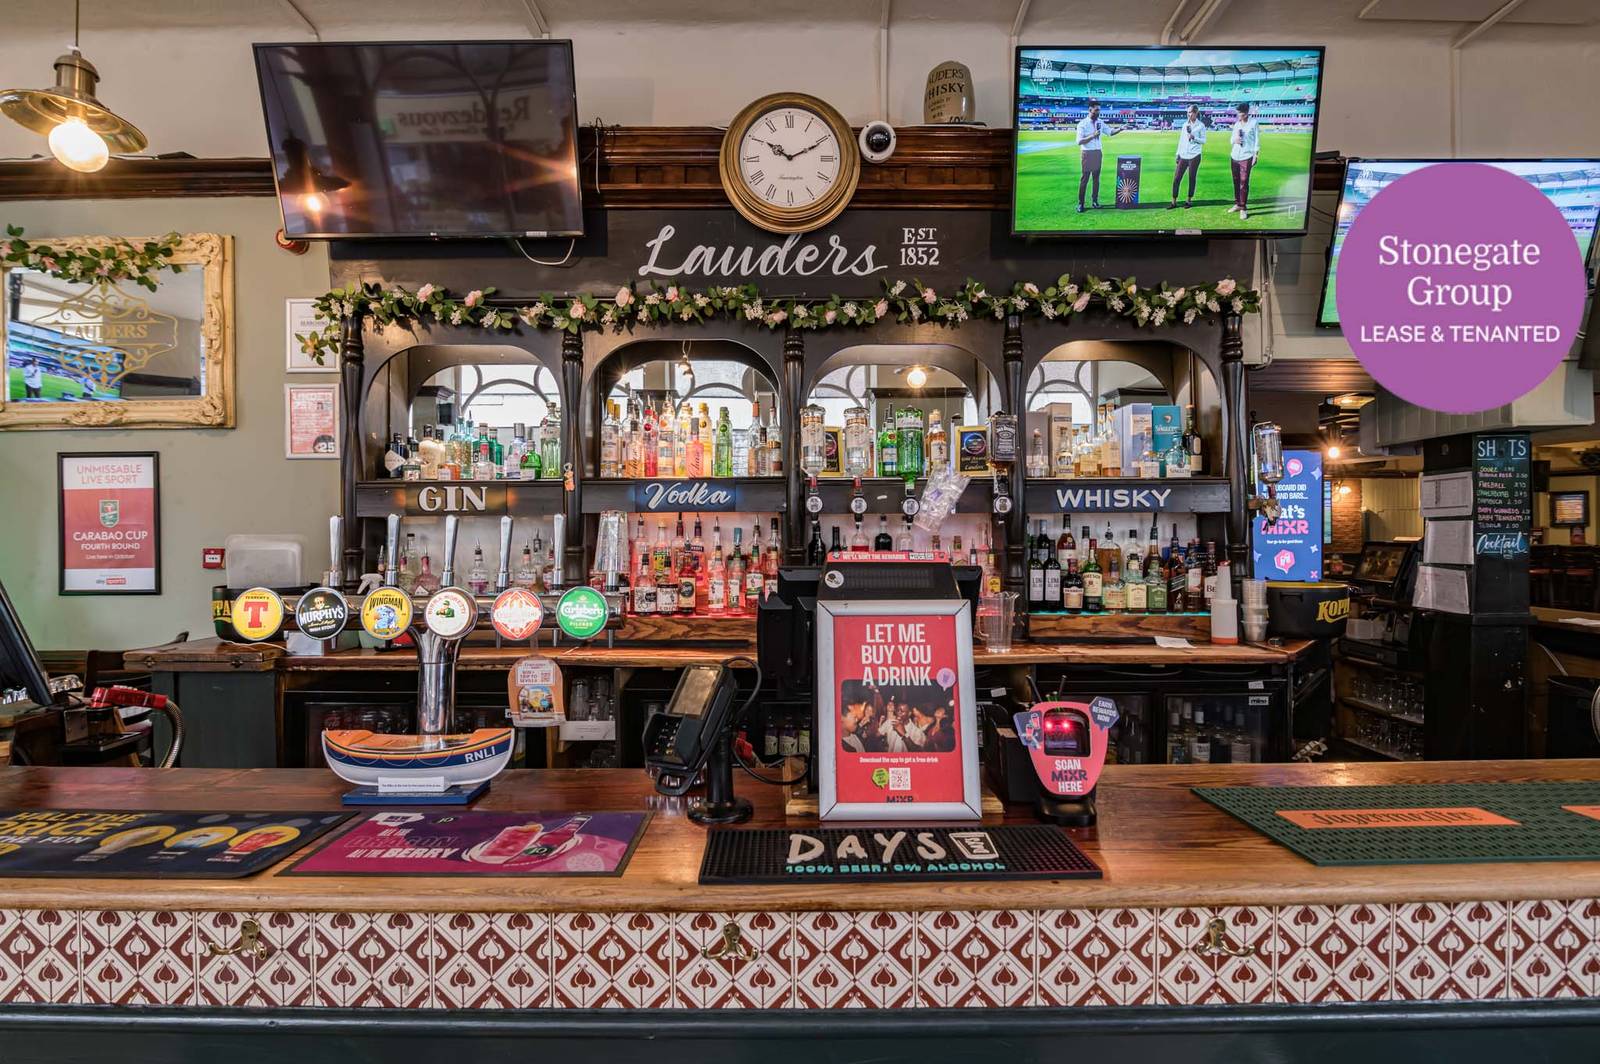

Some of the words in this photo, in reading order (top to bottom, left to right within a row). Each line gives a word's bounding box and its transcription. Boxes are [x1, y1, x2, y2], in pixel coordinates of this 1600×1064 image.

[928, 82, 965, 99] HISKY
[638, 225, 888, 276] Lauders
[900, 247, 939, 266] 1852
[61, 325, 148, 339] LAUDERS
[1478, 440, 1526, 457] SHTS
[77, 464, 143, 474] UNMISSABLE
[81, 475, 102, 484] LIVE
[105, 474, 138, 484] SPORT
[418, 486, 488, 512] GIN
[645, 482, 732, 509] Vodka
[1056, 488, 1172, 508] WHISKY
[73, 532, 123, 541] CARABAO
[126, 530, 148, 540] CUP
[368, 598, 404, 611] WINGMAN
[560, 602, 604, 620] Carlsberg
[244, 601, 268, 628] T
[299, 606, 344, 626] MURPHY'S
[866, 624, 894, 643] LET
[899, 624, 926, 643] ME
[862, 645, 896, 664] BUY
[898, 645, 932, 664] YOU
[862, 666, 874, 686] A
[878, 666, 932, 686] DRINK
[1092, 706, 1117, 717] REWARDS
[1098, 700, 1112, 709] EARN
[1097, 714, 1110, 722] NOW
[464, 746, 496, 763] RNLI
[1055, 759, 1082, 770] SCAN
[1052, 770, 1088, 782] MiXR
[1058, 780, 1084, 792] HERE
[7, 812, 88, 822] HALF
[86, 813, 147, 822] THE
[380, 848, 460, 858] BERRY
[786, 831, 947, 864] DAYS
[786, 864, 834, 874] 100%
[894, 864, 921, 872] 0%
[927, 863, 1006, 871] ALCOHOL
